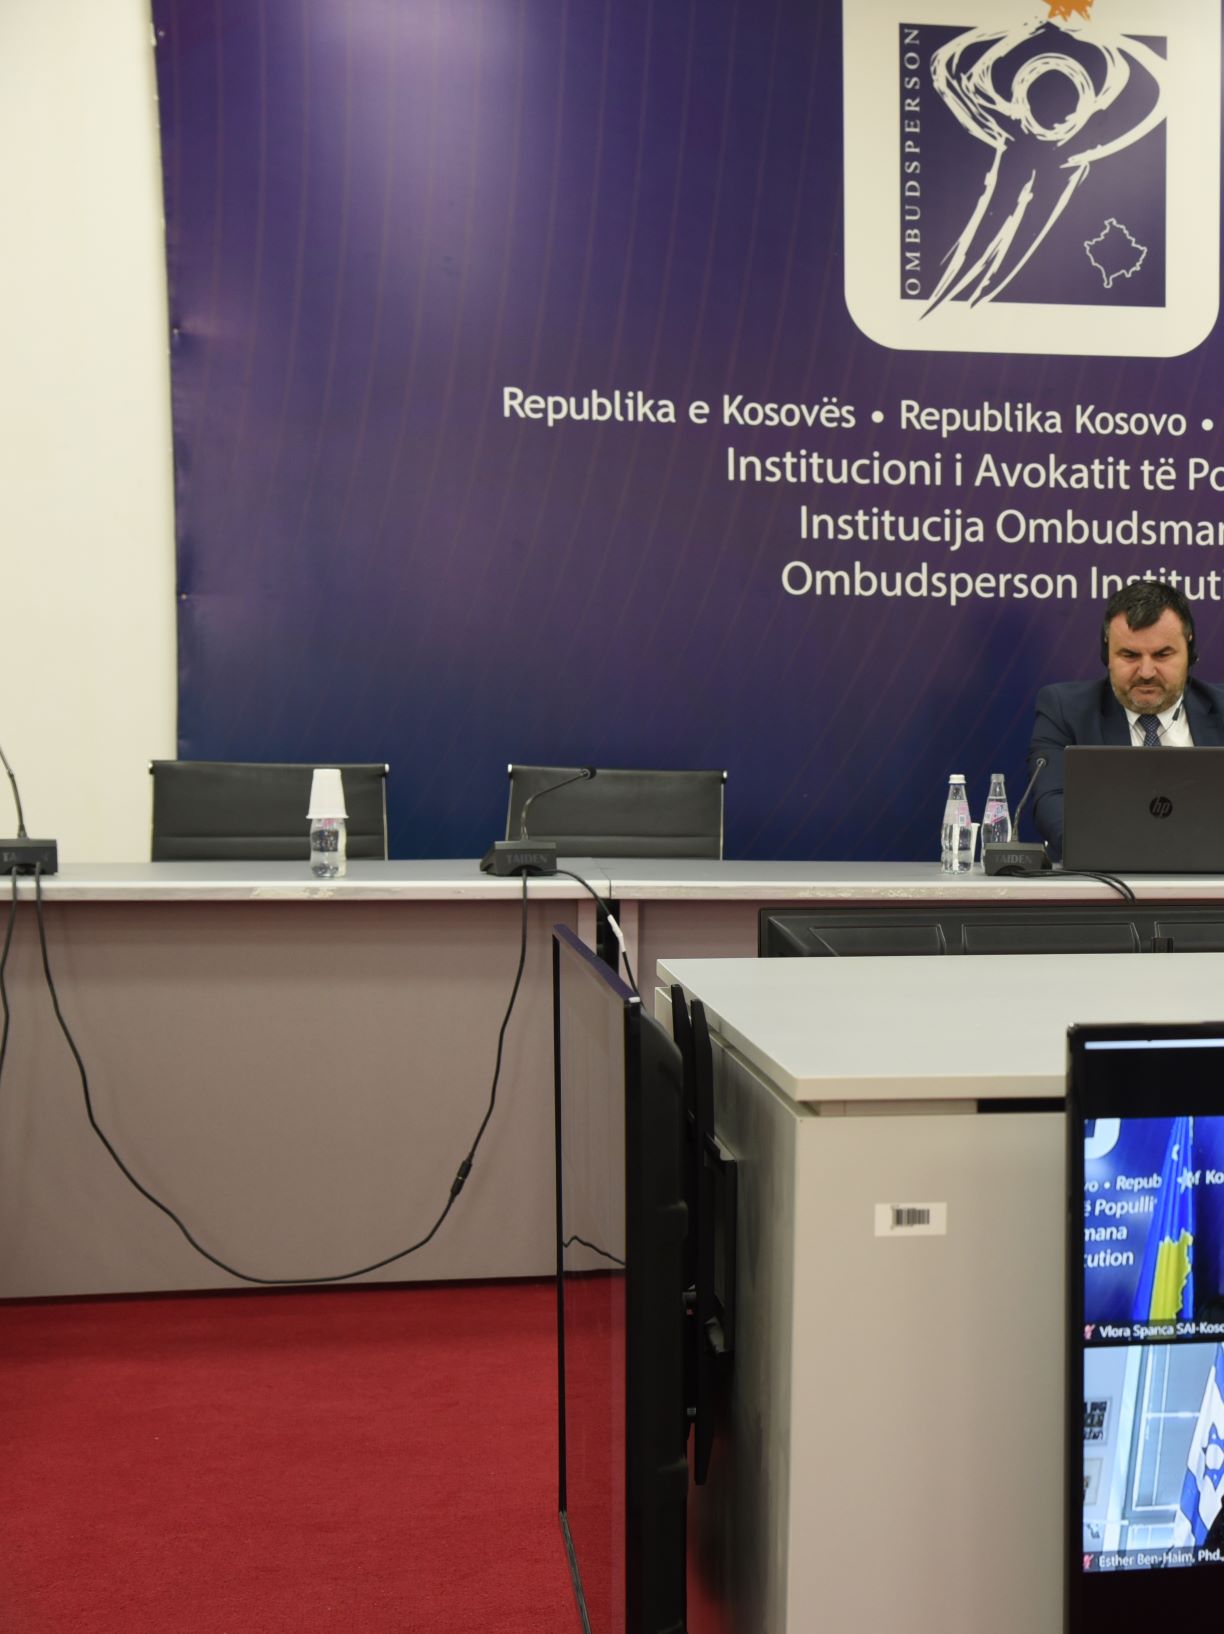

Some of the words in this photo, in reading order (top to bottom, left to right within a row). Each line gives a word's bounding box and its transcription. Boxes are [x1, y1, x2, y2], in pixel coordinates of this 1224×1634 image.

[904, 28, 921, 296] OMBUDSPERSON
[503, 386, 676, 428] Republika
[688, 400, 710, 424] e
[723, 394, 856, 429] Kosovës
[900, 399, 1063, 439] Republika
[1075, 404, 1187, 437] Kosovo
[727, 446, 942, 486] Institucioni
[955, 452, 962, 487] i
[974, 453, 1131, 490] Avokatit
[1140, 457, 1177, 491] të
[800, 505, 984, 552] Institucija
[781, 560, 1078, 607] Ombudsperson
[1116, 1173, 1162, 1192] Repub
[1100, 1325, 1131, 1338] Vlora
[1099, 1552, 1134, 1568] Esther
